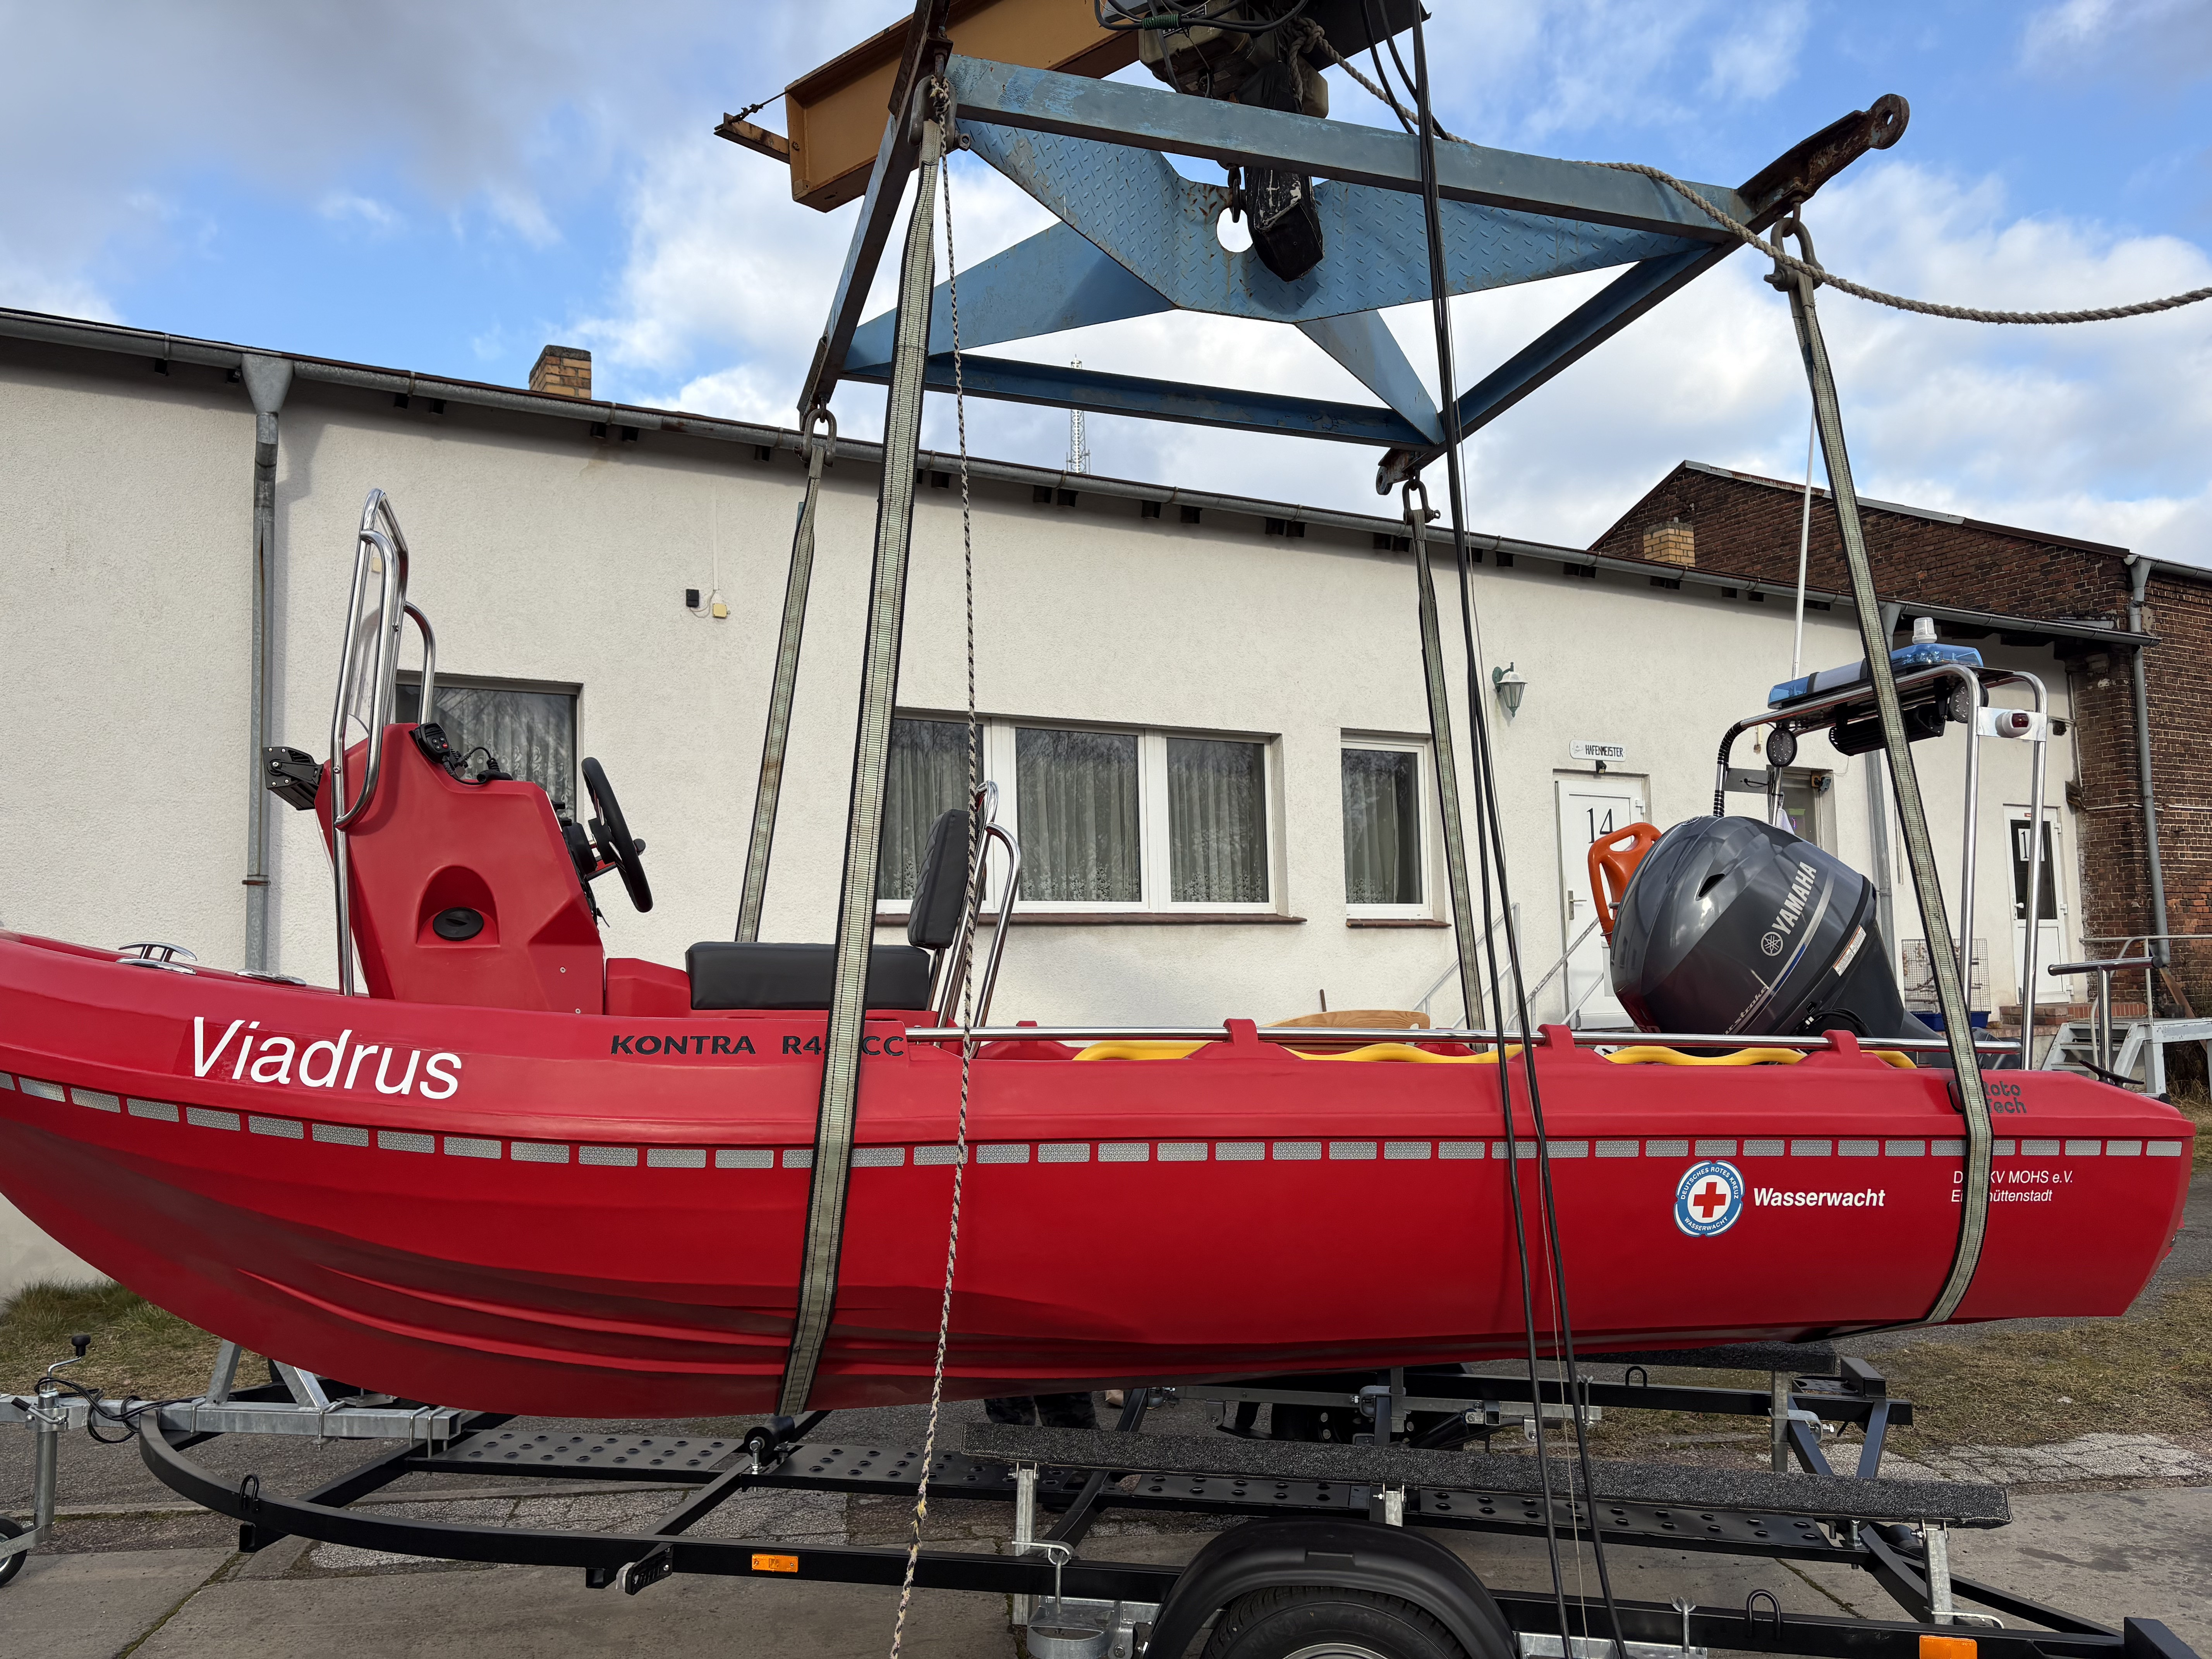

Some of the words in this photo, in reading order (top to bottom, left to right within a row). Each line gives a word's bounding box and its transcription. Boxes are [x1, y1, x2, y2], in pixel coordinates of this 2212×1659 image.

[1585, 744, 1624, 757] HAFENMEISTER
[1587, 807, 1613, 843] 14
[1772, 861, 1817, 934] YAMAHA
[611, 1035, 756, 1055] KONTRA
[194, 1016, 462, 1099] Viadrus
[1680, 1167, 1709, 1200] DEUTSCHES
[1711, 1166, 1730, 1178] ROTES
[1729, 1176, 1739, 1199] KREUZ
[2008, 1170, 2049, 1183] MOHS
[2052, 1170, 2073, 1183] e.V.
[1753, 1188, 1886, 1206] Wasserwacht
[1684, 1216, 1728, 1231] WASSERWACHT
